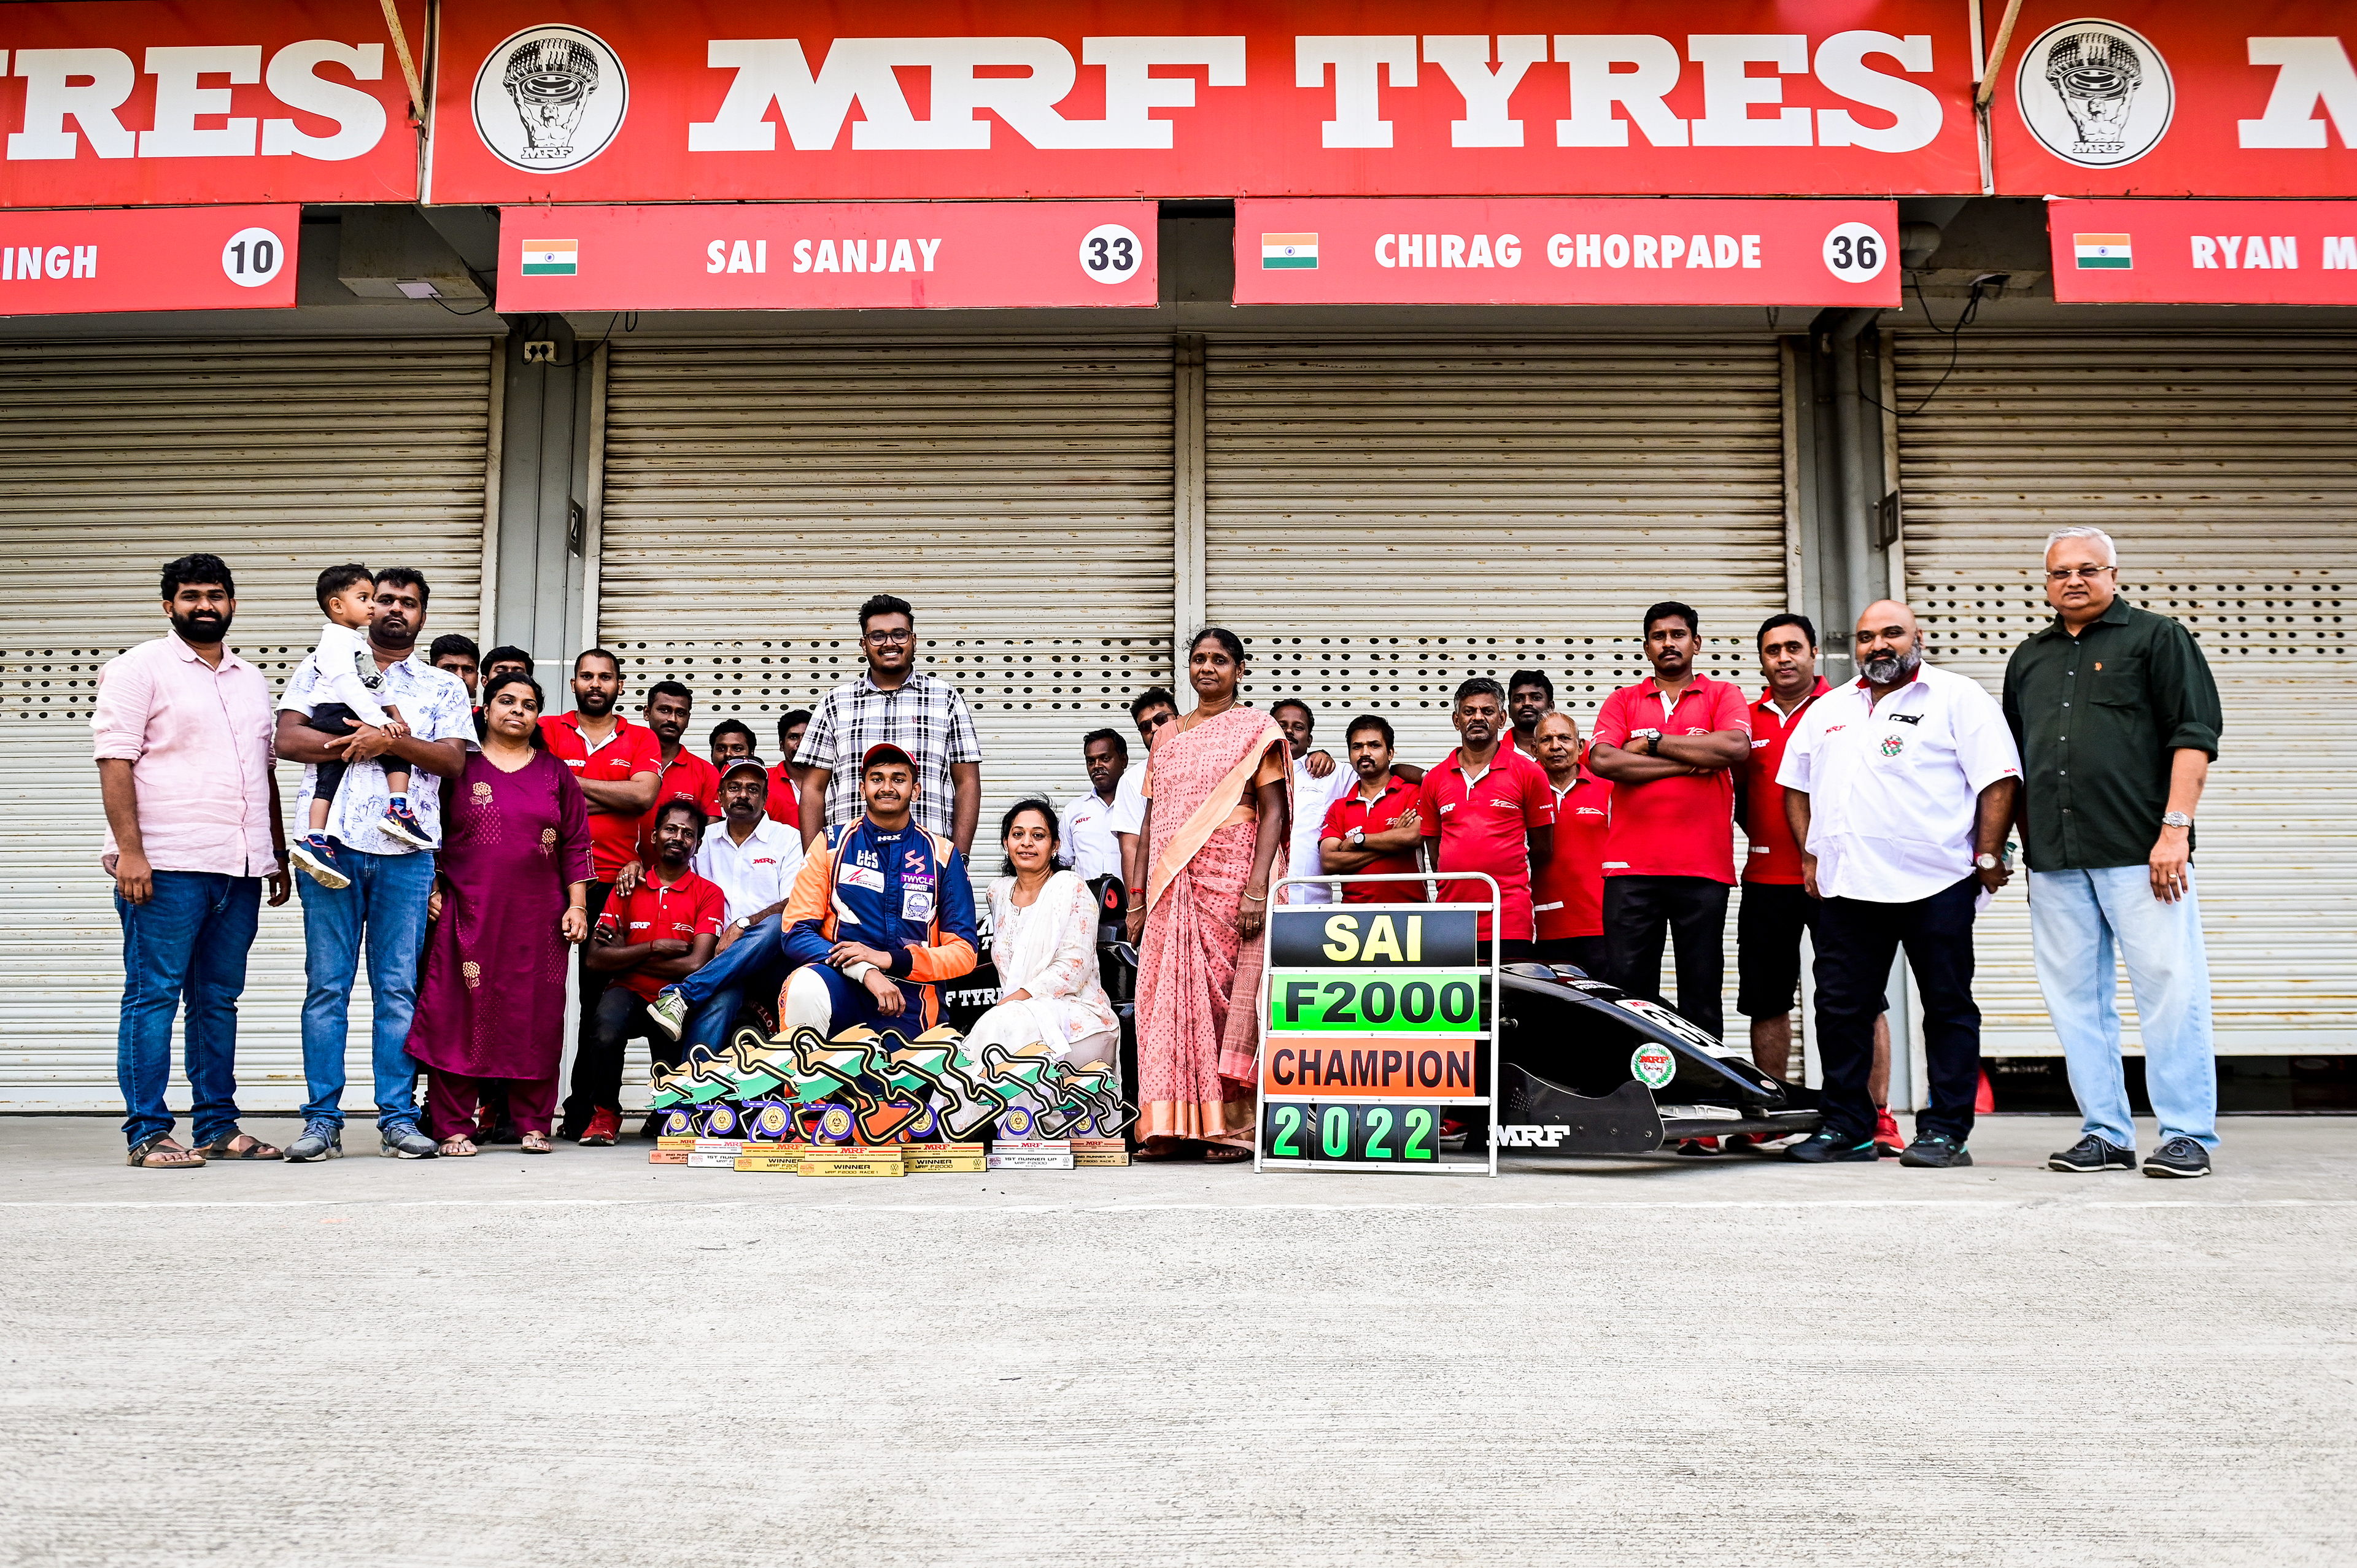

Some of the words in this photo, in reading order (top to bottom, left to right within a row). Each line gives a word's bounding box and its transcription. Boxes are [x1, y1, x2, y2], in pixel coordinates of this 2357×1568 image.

[0, 40, 387, 161] RES
[688, 36, 1247, 152] MRF
[1295, 30, 1943, 153] TYRES
[521, 147, 573, 159] MRF
[2073, 141, 2125, 153] MRF
[230, 240, 274, 274] 10
[706, 238, 767, 274] SAI
[792, 238, 943, 274] SANJAY
[1088, 238, 1133, 271] 33
[1374, 233, 1522, 269] CHIRAG
[1546, 233, 1762, 269] GHORPADE
[1833, 236, 1876, 269] 36
[2191, 235, 2299, 270] RYAN
[877, 833, 902, 842] HRX
[902, 874, 935, 886] TWYCLE
[1322, 914, 1422, 962] SAI
[1285, 981, 1475, 1024] F2000
[1272, 1048, 1471, 1089] CHAMPION
[1639, 1055, 1670, 1064] MRF
[1644, 1063, 1664, 1074] Racing
[1273, 1106, 1433, 1159] 2022
[1486, 1124, 1571, 1148] MRF
